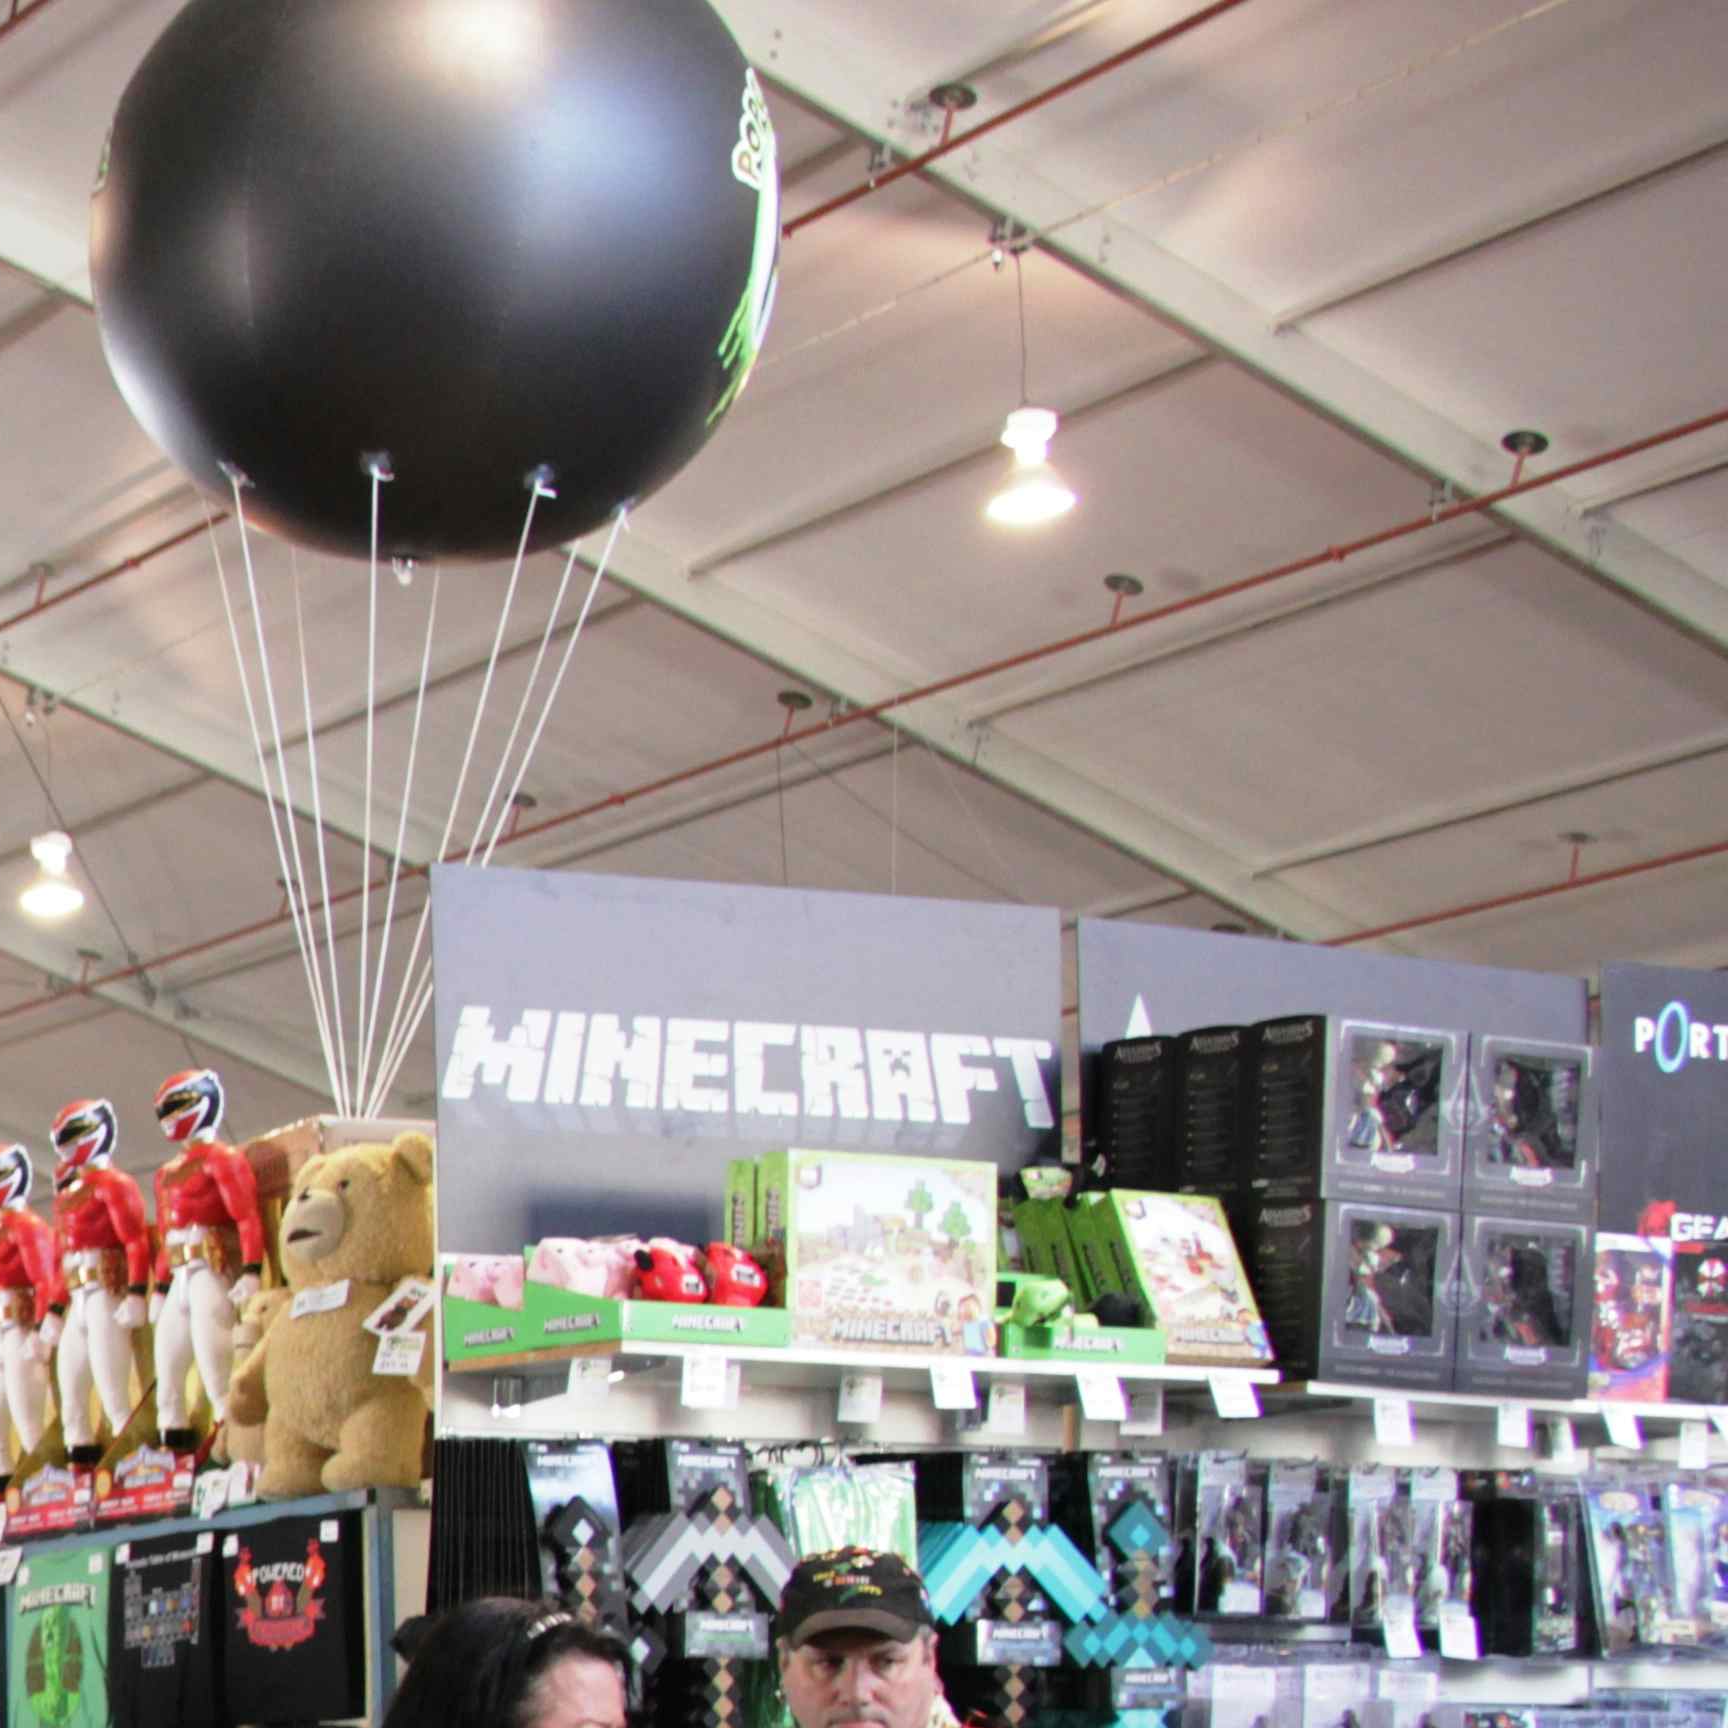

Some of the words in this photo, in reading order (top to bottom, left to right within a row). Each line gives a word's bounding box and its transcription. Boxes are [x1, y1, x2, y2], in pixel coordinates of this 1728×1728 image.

[442, 1005, 1054, 1129] MINECRAFT
[830, 1317, 955, 1345] MINECRAFT
[250, 1562, 304, 1584] POWERED
